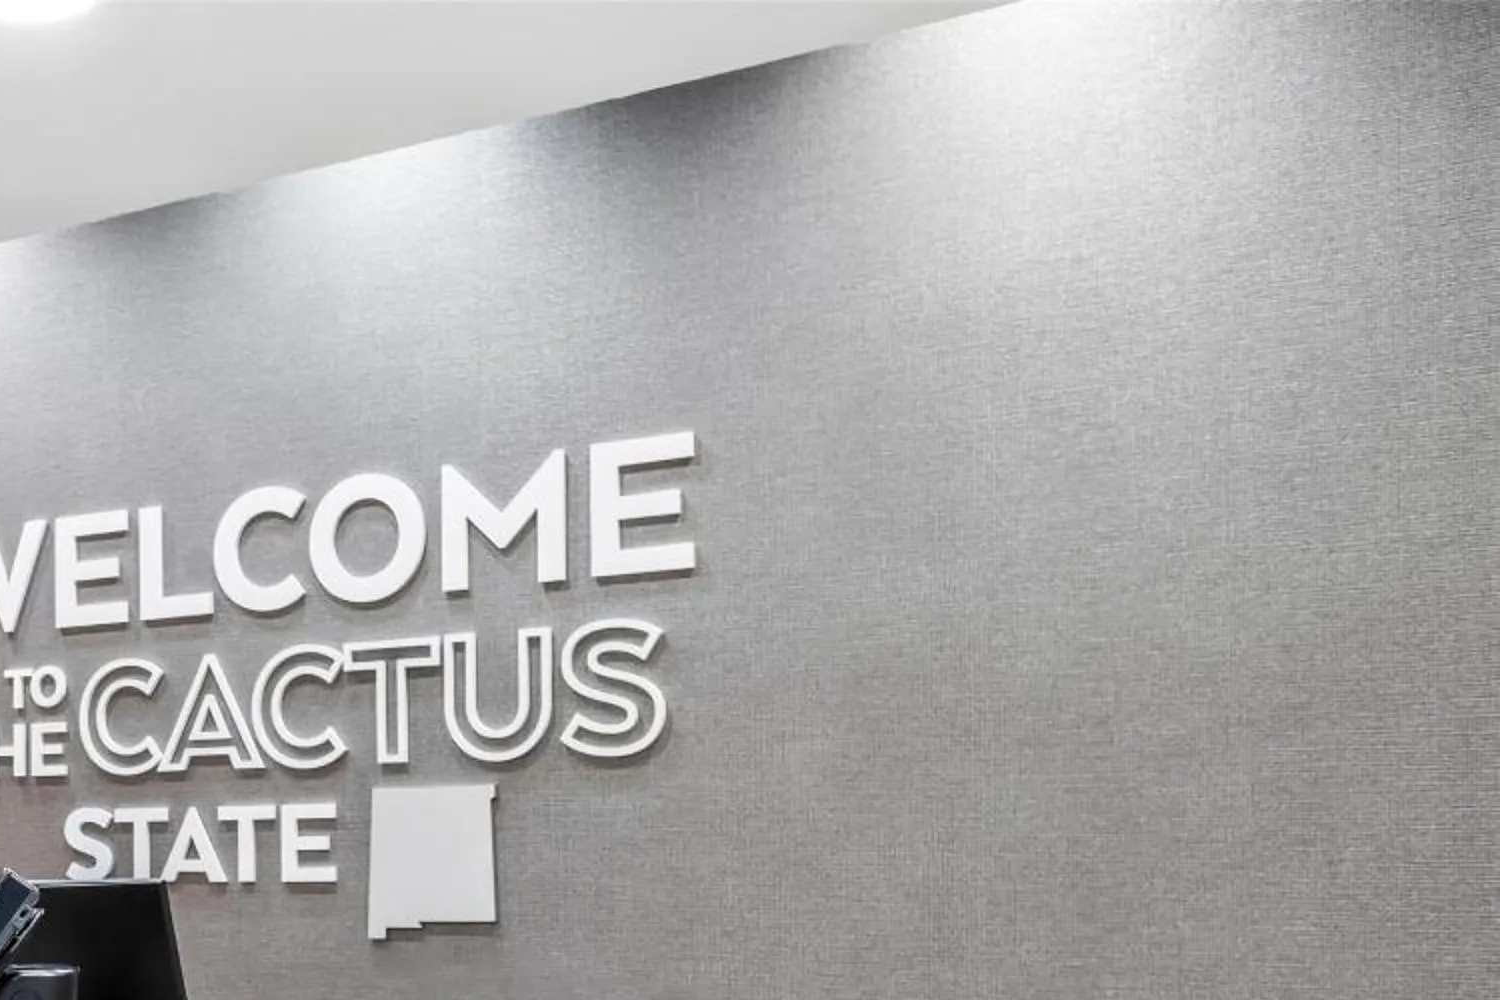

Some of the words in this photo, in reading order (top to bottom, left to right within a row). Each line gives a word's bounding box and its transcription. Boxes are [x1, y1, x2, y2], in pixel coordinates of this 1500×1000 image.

[3, 665, 67, 709] TO
[79, 617, 668, 777] CACTUS
[63, 803, 338, 883] STATE
